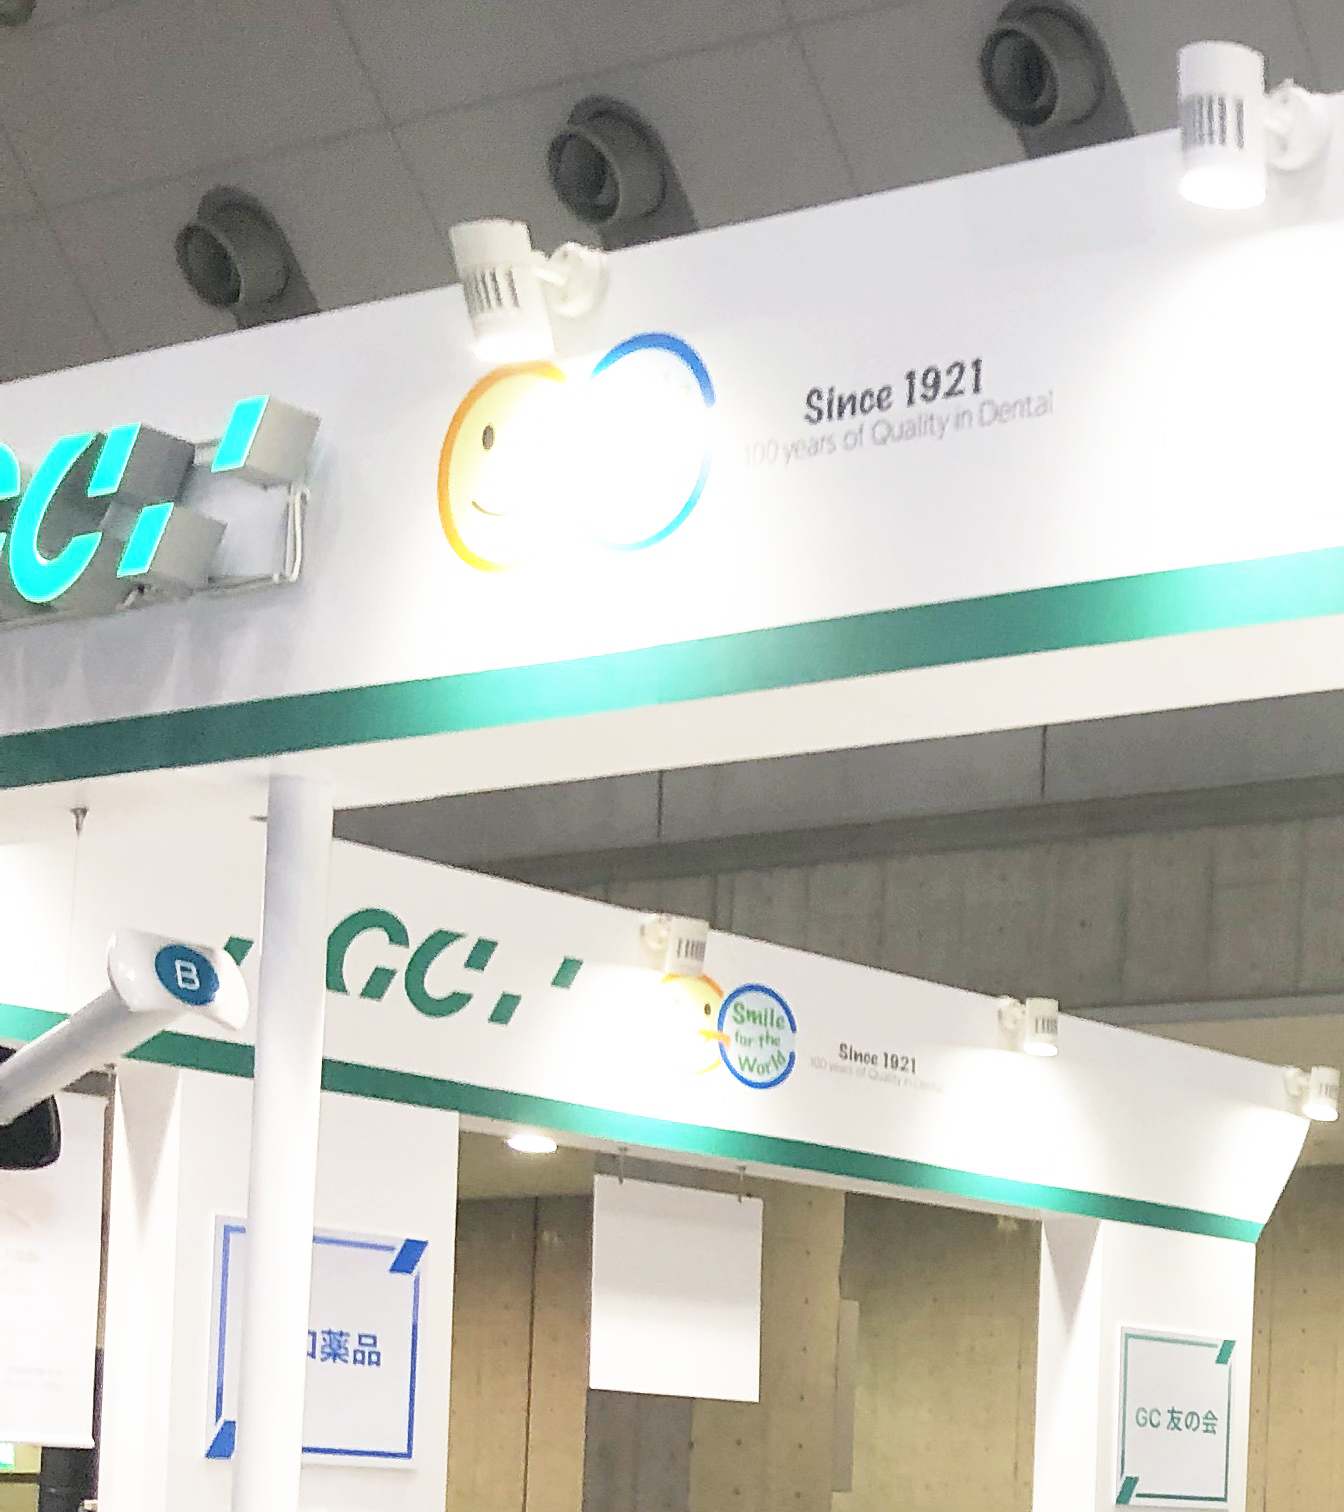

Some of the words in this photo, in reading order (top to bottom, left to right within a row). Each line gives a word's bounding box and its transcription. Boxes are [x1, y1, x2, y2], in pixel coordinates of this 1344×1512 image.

[804, 386, 893, 425] Since
[904, 357, 983, 408] 1921
[784, 431, 836, 467] years
[843, 422, 865, 451] of
[872, 411, 949, 447] Quality
[954, 404, 973, 431] in
[980, 390, 1054, 428] Dental
[174, 959, 200, 990] B
[326, 907, 510, 1023] GC
[732, 1002, 785, 1031] Smile
[735, 1029, 757, 1047] for
[759, 1030, 781, 1048] the
[738, 1050, 787, 1076] World
[838, 1043, 878, 1067] Since
[883, 1051, 917, 1075] 1921
[1135, 1406, 1161, 1429] GC
[1166, 1406, 1218, 1435] 友の会
